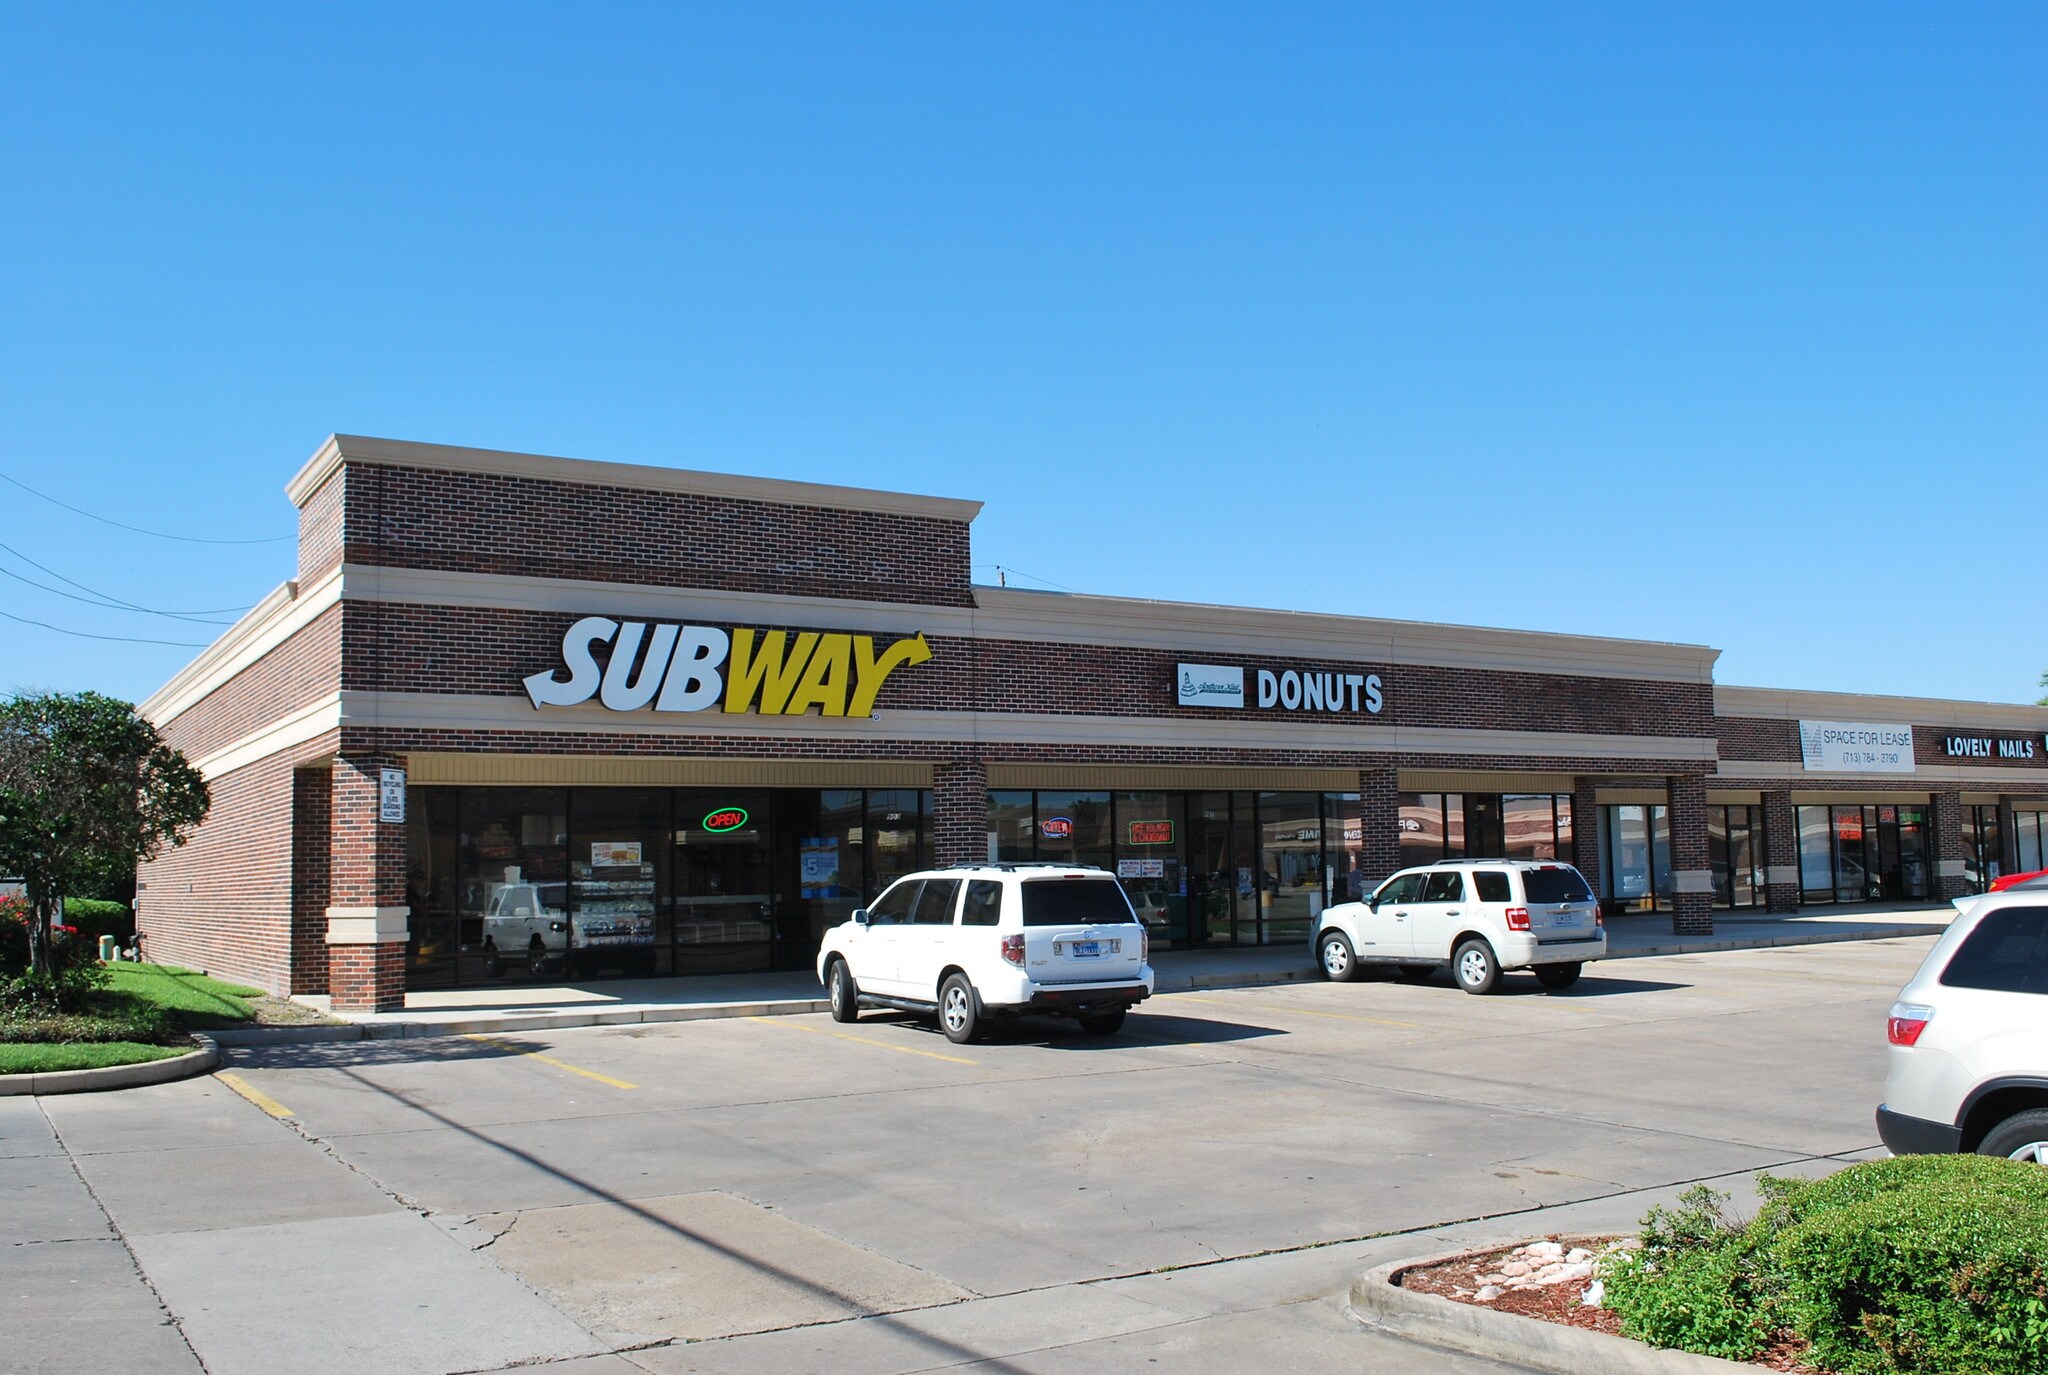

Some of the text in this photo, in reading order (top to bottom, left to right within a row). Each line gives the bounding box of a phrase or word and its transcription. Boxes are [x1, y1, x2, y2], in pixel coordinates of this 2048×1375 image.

[522, 616, 933, 718] SUBWAY
[1258, 669, 1383, 714] DONUTS
[1823, 729, 1911, 747] SPACE FOR LEASE
[1946, 736, 1992, 757] LOVELY
[1999, 740, 2034, 759] NAILS
[1842, 752, 1861, 765] (713)
[1862, 753, 1876, 764] 784
[1881, 753, 1899, 765] 3790
[708, 812, 741, 827] OPEN
